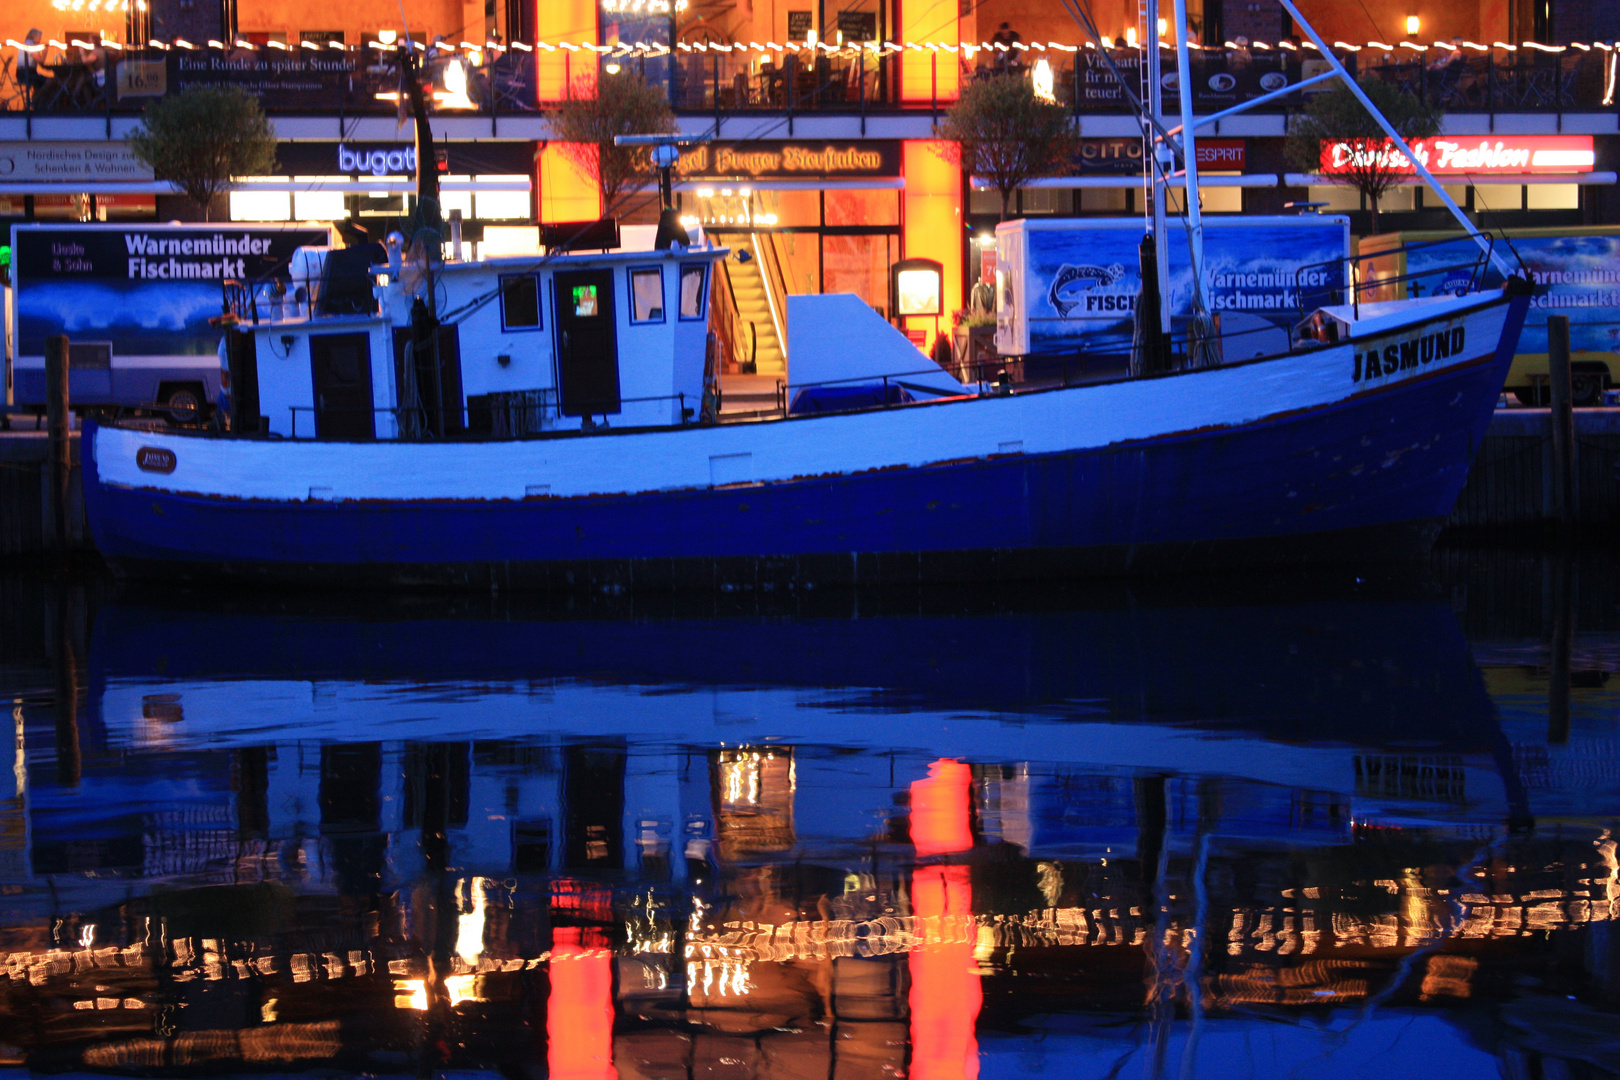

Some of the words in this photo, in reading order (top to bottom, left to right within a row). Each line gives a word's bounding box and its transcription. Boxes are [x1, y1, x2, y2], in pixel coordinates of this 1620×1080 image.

[179, 57, 207, 71] Eine
[211, 57, 251, 71] Runde
[254, 60, 268, 71] zu
[271, 58, 307, 74] später
[309, 57, 357, 71] Stunde!
[1085, 53, 1110, 68] Vie
[1114, 57, 1139, 68] satt
[1085, 85, 1122, 99] teuer!
[27, 150, 81, 160] Nordisches
[84, 150, 118, 162] Design
[339, 143, 417, 176] bugat
[1081, 143, 1143, 159] CITO
[1197, 148, 1244, 162] ESPRIT
[1435, 141, 1529, 168] Fashion
[34, 163, 81, 174] Schenken
[84, 163, 92, 174] &
[95, 163, 136, 174] Wohnen
[715, 148, 781, 175] Prager
[125, 234, 272, 256] Warnemünder
[128, 257, 246, 279] Fischmarkt
[1209, 289, 1304, 309] ischmarkt
[1352, 326, 1465, 383] JASMUND
